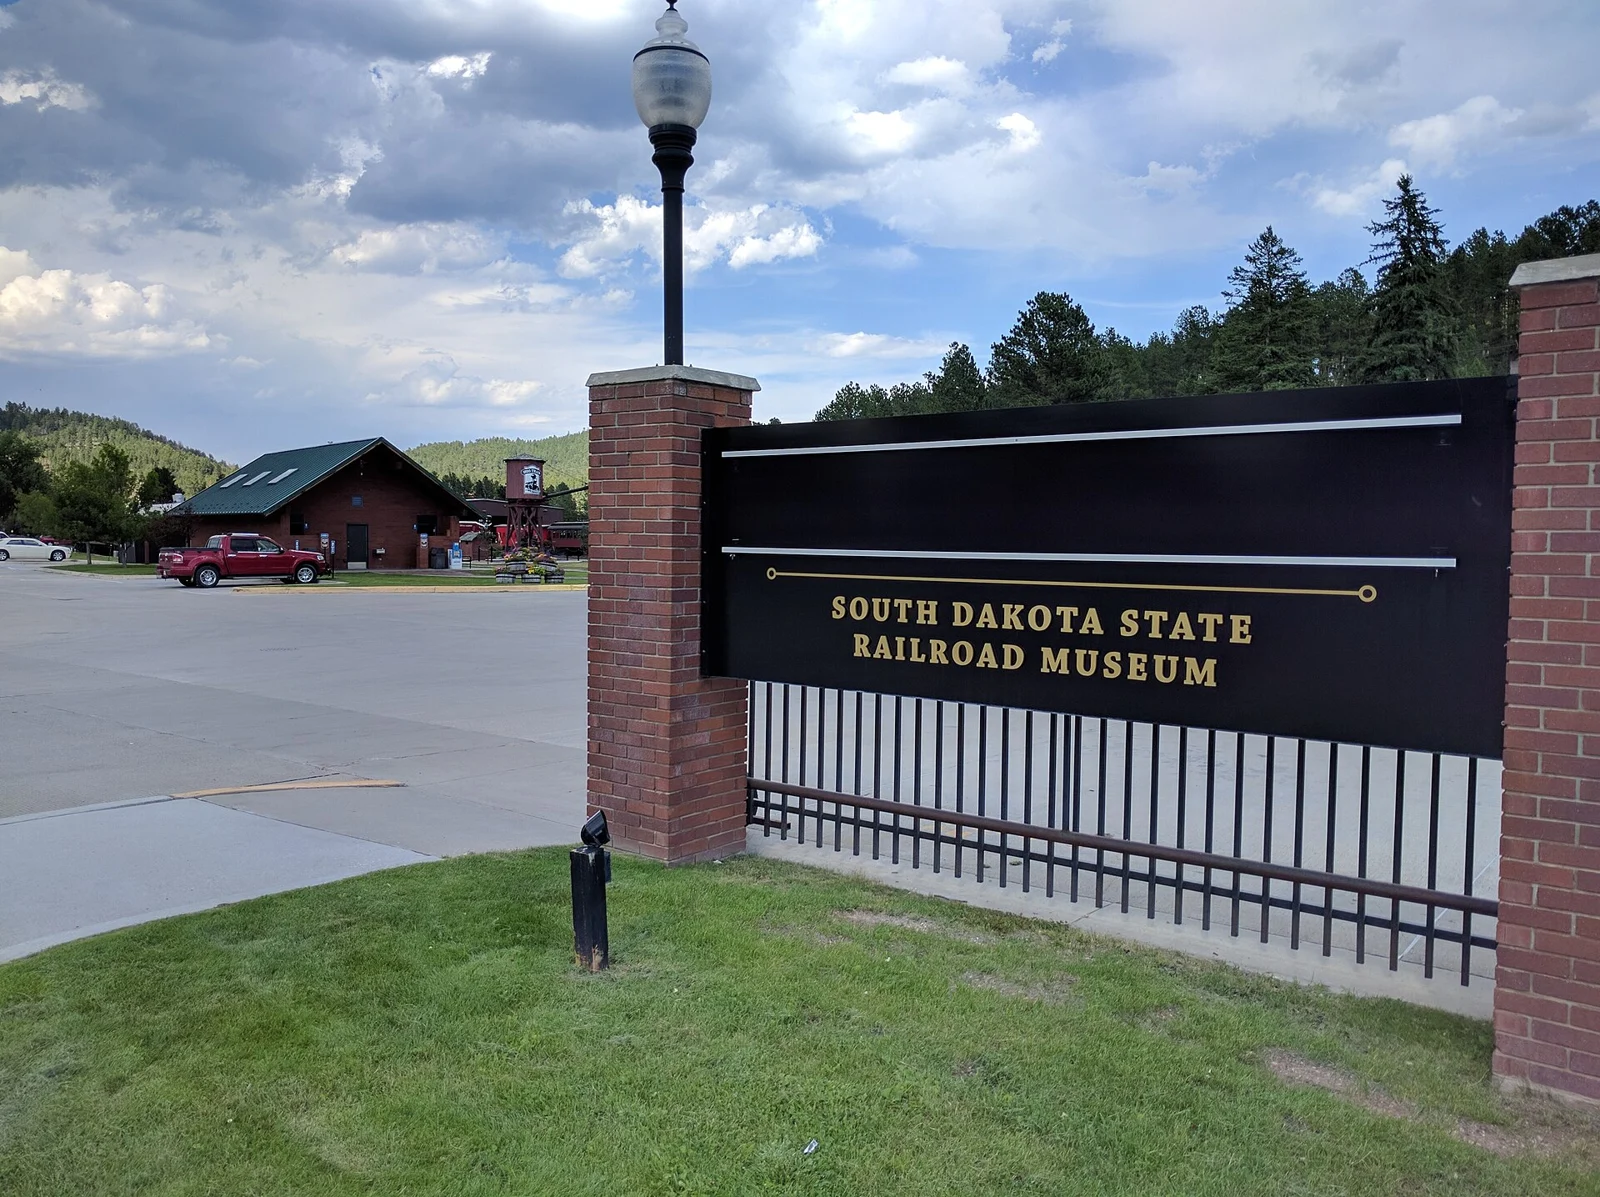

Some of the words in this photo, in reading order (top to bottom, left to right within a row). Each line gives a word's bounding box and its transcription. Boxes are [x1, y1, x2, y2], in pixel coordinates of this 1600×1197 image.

[831, 595, 938, 625] SOUTH
[952, 601, 1105, 635] DAKOTA
[1119, 609, 1252, 645] STATE
[853, 633, 1025, 670] RAILROAD
[1040, 646, 1218, 687] MUSEUM
